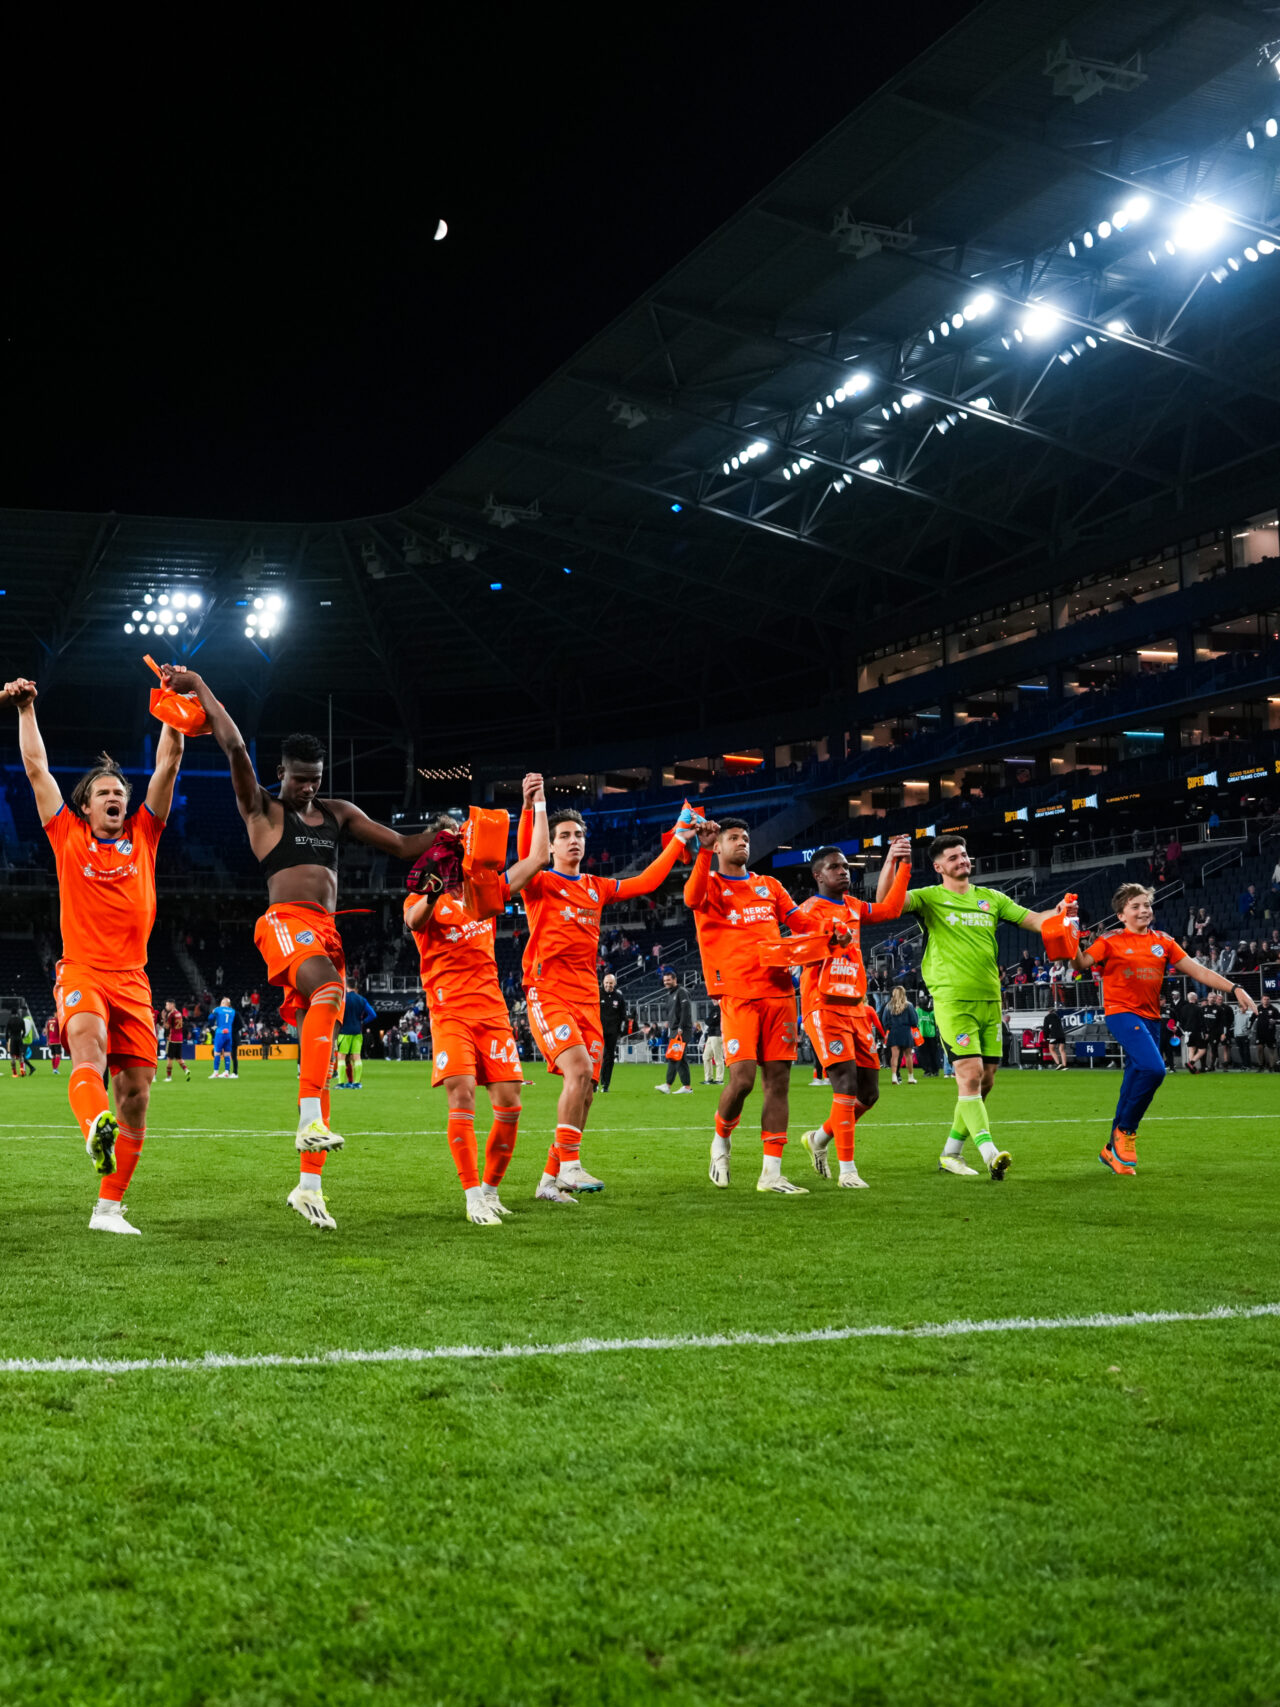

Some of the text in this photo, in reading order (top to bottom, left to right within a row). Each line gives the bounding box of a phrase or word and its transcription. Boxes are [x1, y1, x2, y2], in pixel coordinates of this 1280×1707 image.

[743, 906, 771, 915] MERCY
[961, 912, 990, 920] MERCY
[962, 919, 993, 927] HEALTH
[830, 966, 858, 977] CINCY
[1265, 980, 1276, 988] W5
[225, 1013, 230, 1023] 1
[1063, 1014, 1084, 1027] TQL
[489, 1037, 520, 1063] 42
[1086, 1045, 1094, 1053] F6
